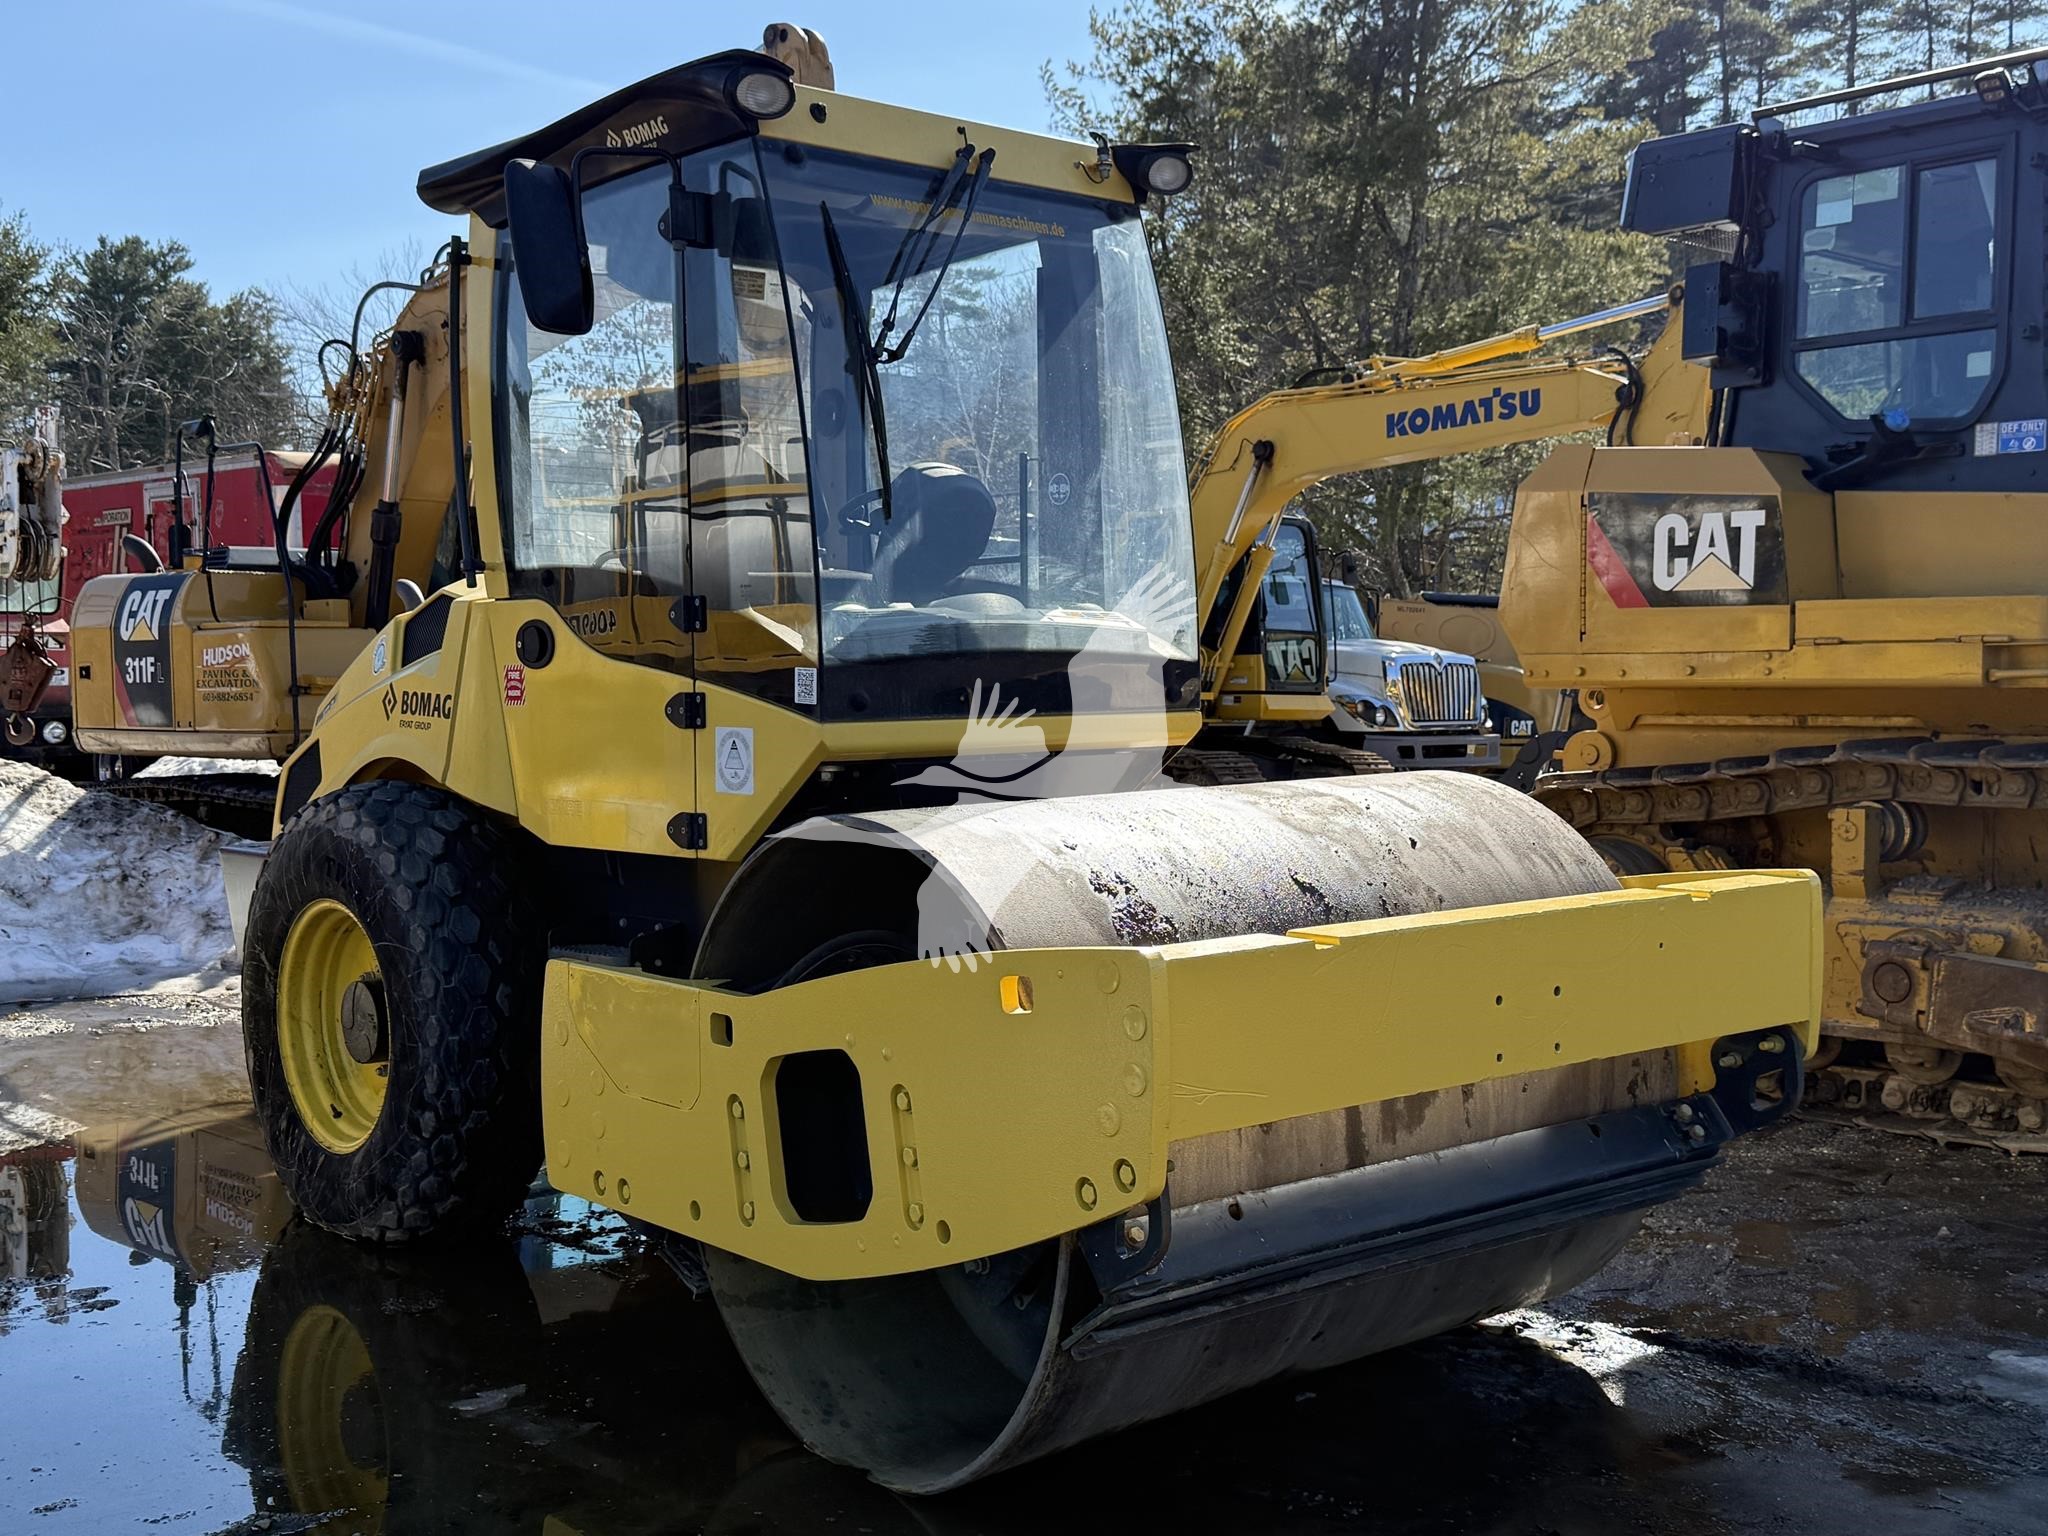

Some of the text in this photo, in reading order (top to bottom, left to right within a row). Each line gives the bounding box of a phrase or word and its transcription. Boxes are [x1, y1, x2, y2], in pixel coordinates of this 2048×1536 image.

[622, 115, 669, 148] BOMAG
[1386, 387, 1541, 439] KOMATSU
[2001, 422, 2044, 434] DEF ONLY
[1653, 509, 1766, 592] CAT
[120, 589, 173, 641] CAT
[203, 643, 250, 667] HUDSON
[125, 656, 155, 684] 311F
[203, 669, 250, 679] PAVING &
[196, 679, 260, 689] EXCAVATION
[401, 690, 452, 720] BOMAG
[414, 721, 432, 731] GROUP
[1511, 720, 1534, 736] CAT
